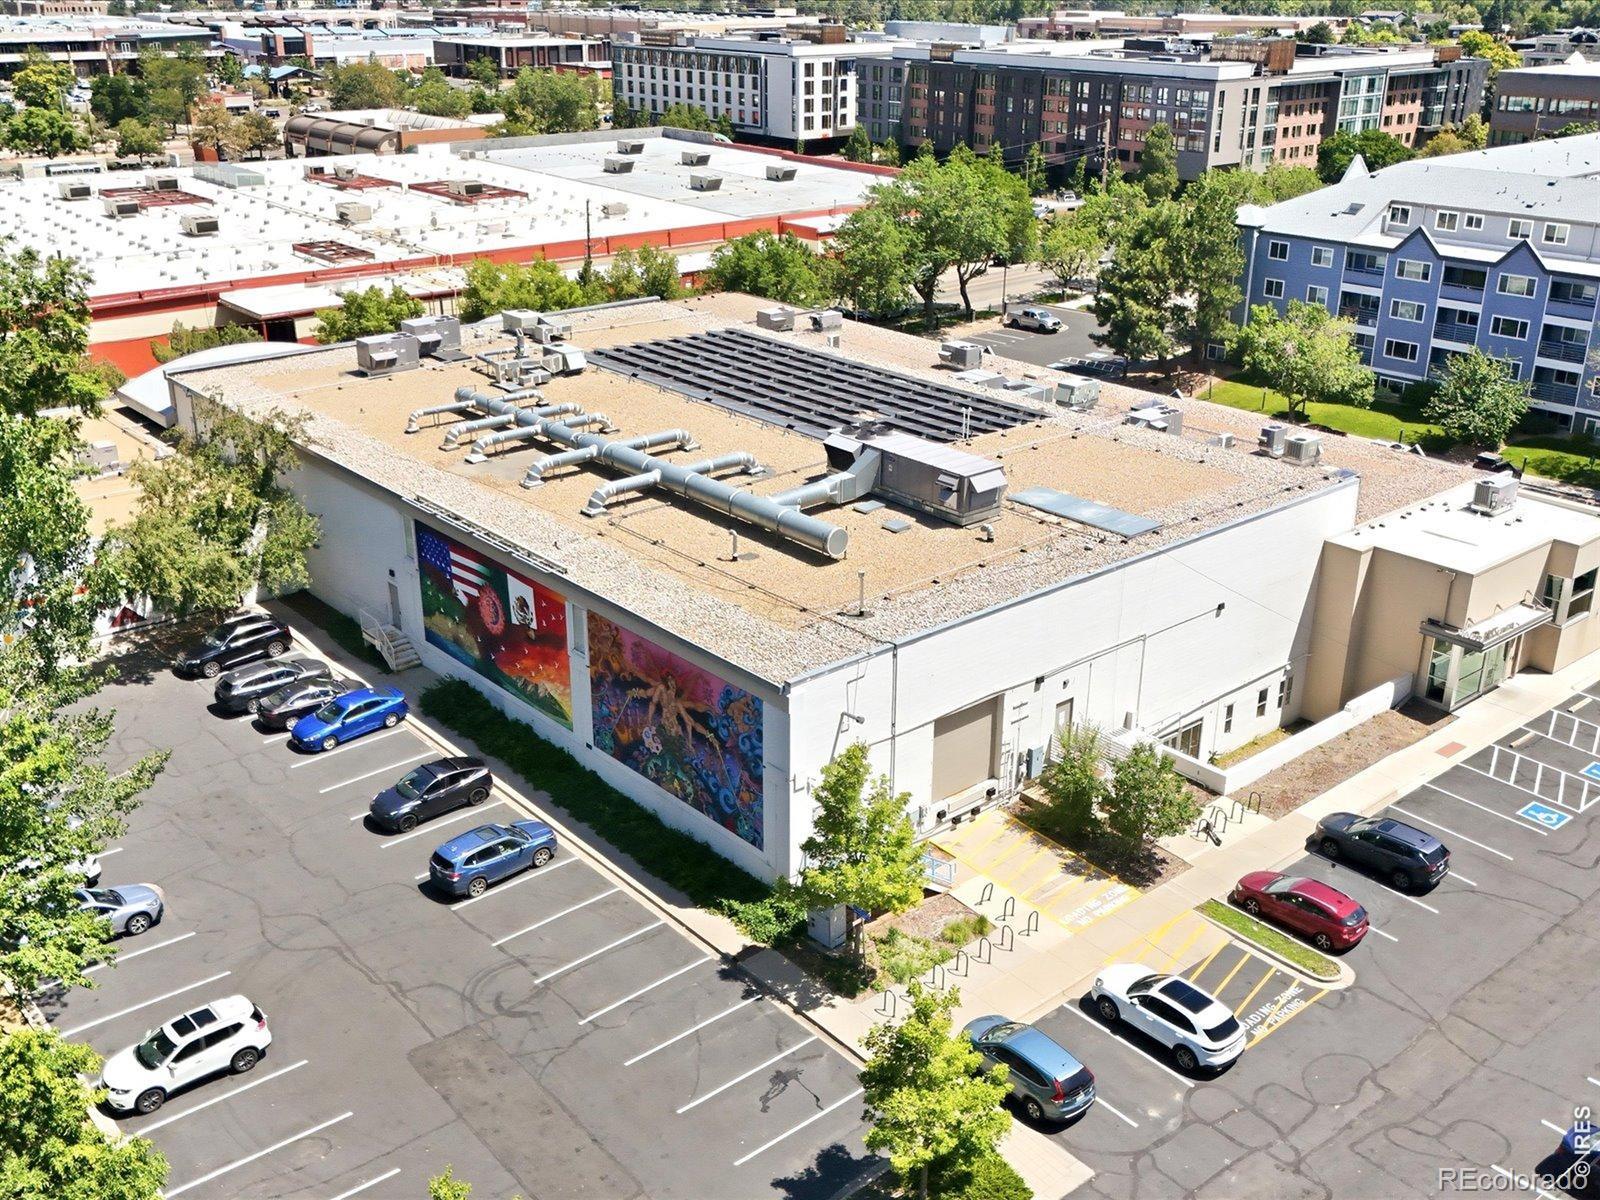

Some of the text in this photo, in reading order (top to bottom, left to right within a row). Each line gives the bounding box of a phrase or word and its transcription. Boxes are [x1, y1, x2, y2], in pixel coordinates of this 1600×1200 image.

[1242, 987, 1304, 1030] OADING ZONE
[1250, 998, 1306, 1036] NO PARKING
